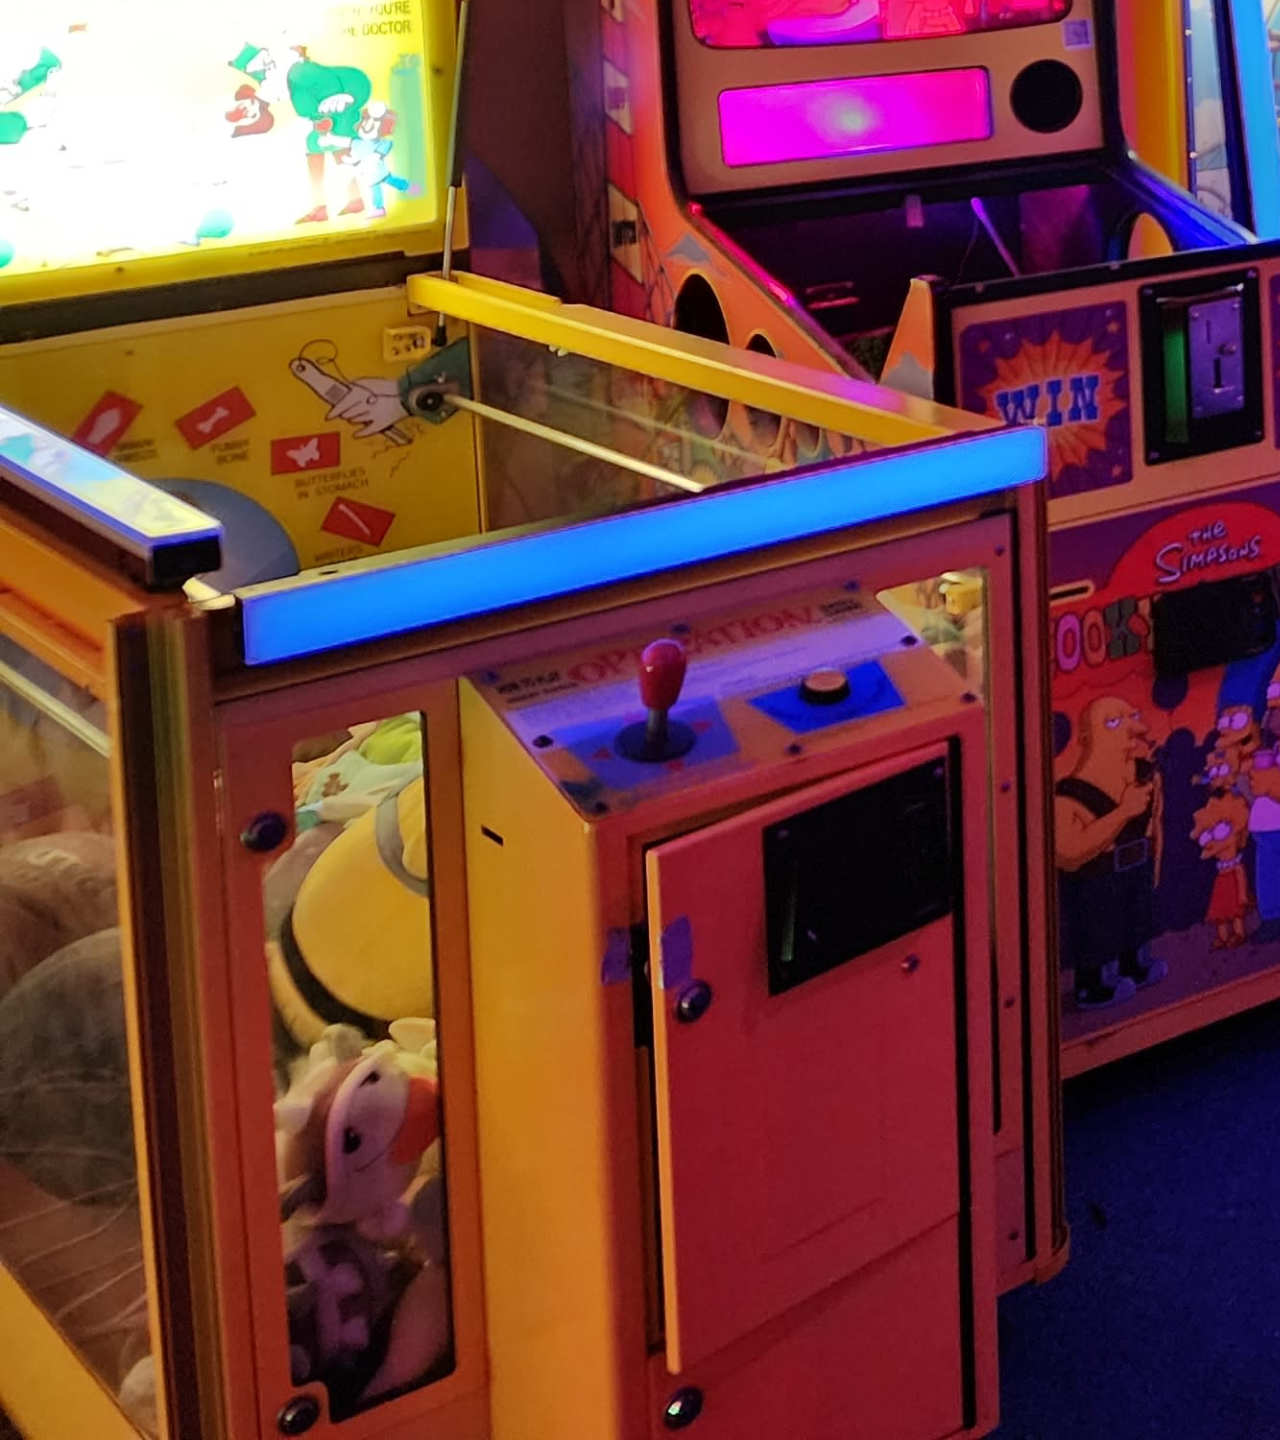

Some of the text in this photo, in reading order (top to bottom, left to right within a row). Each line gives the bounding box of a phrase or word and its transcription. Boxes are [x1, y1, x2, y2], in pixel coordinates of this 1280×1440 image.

[994, 372, 1101, 428] WIN
[1188, 520, 1227, 542] THE
[1156, 535, 1262, 583] SIMPSONS
